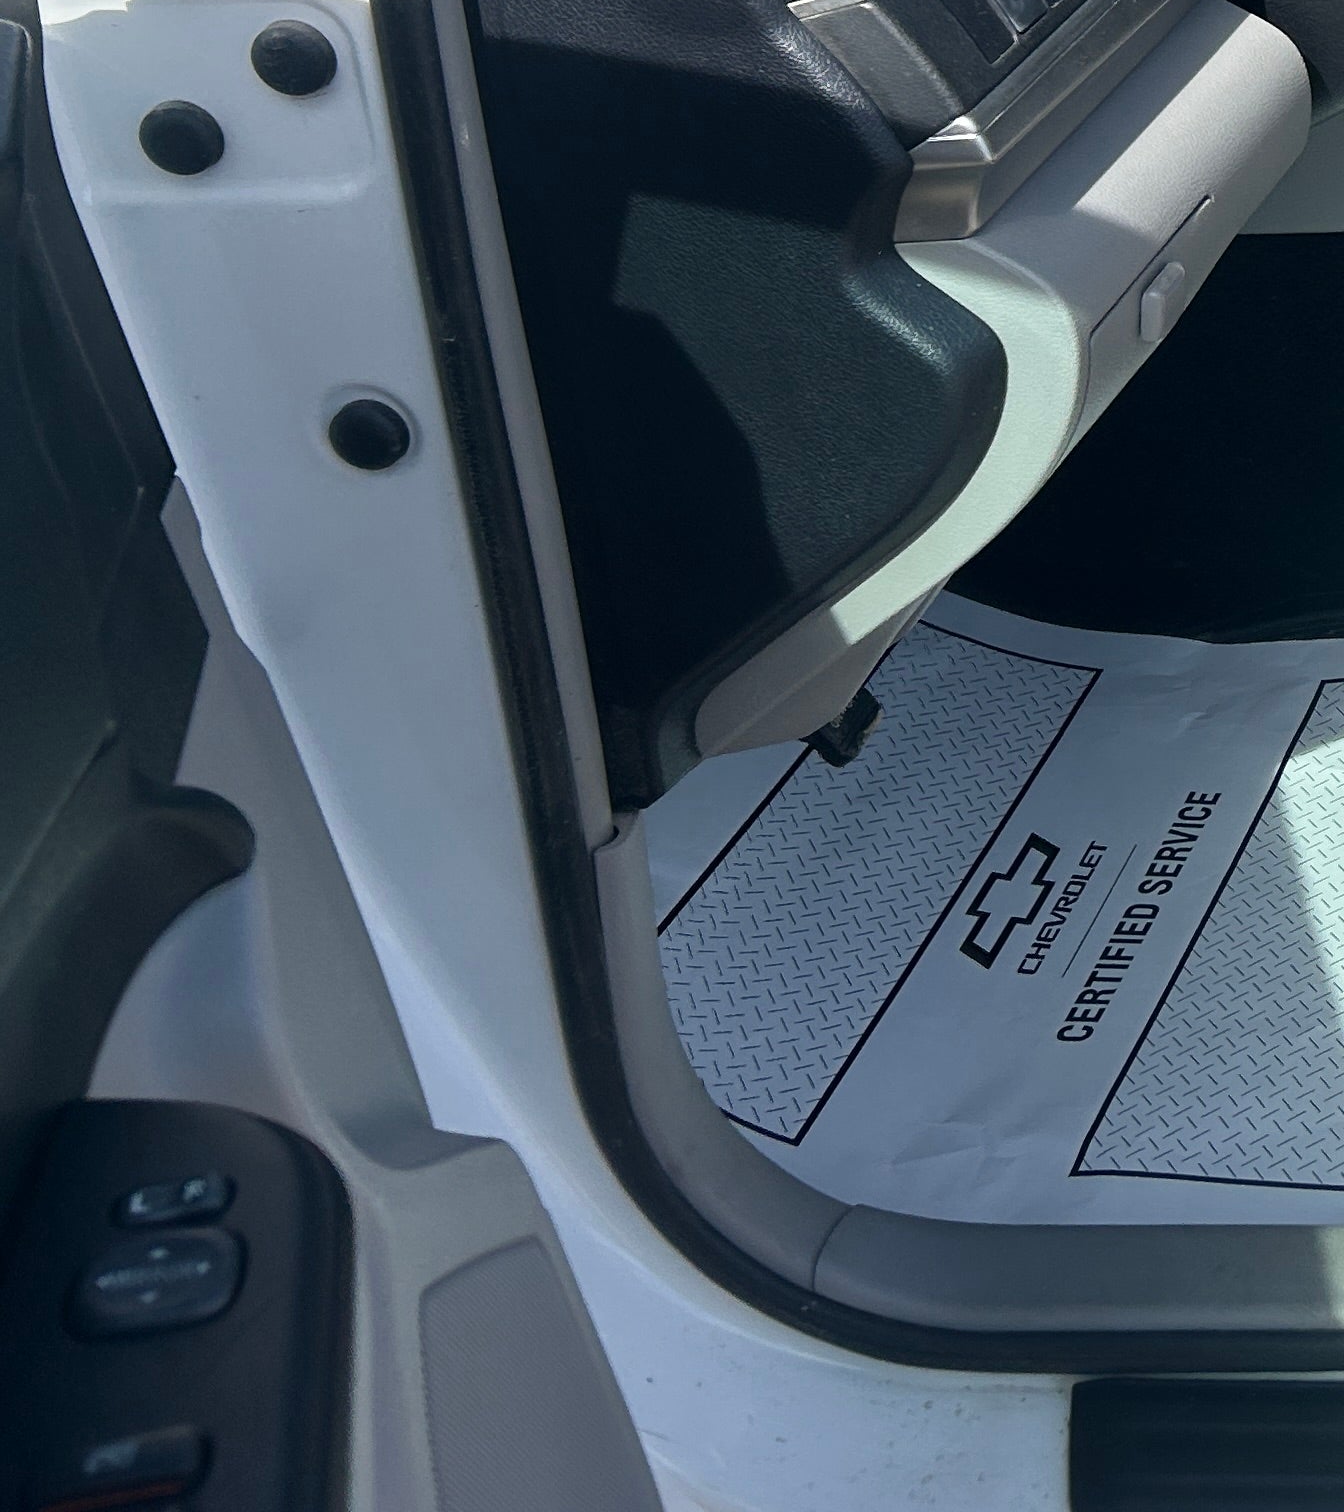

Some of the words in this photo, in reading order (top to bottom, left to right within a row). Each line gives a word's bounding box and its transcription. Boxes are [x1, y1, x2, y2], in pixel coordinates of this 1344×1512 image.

[1017, 840, 1107, 975] CHEVROLET
[1056, 902, 1160, 1042] CERTIFIED
[1138, 791, 1222, 895] SERVICE
